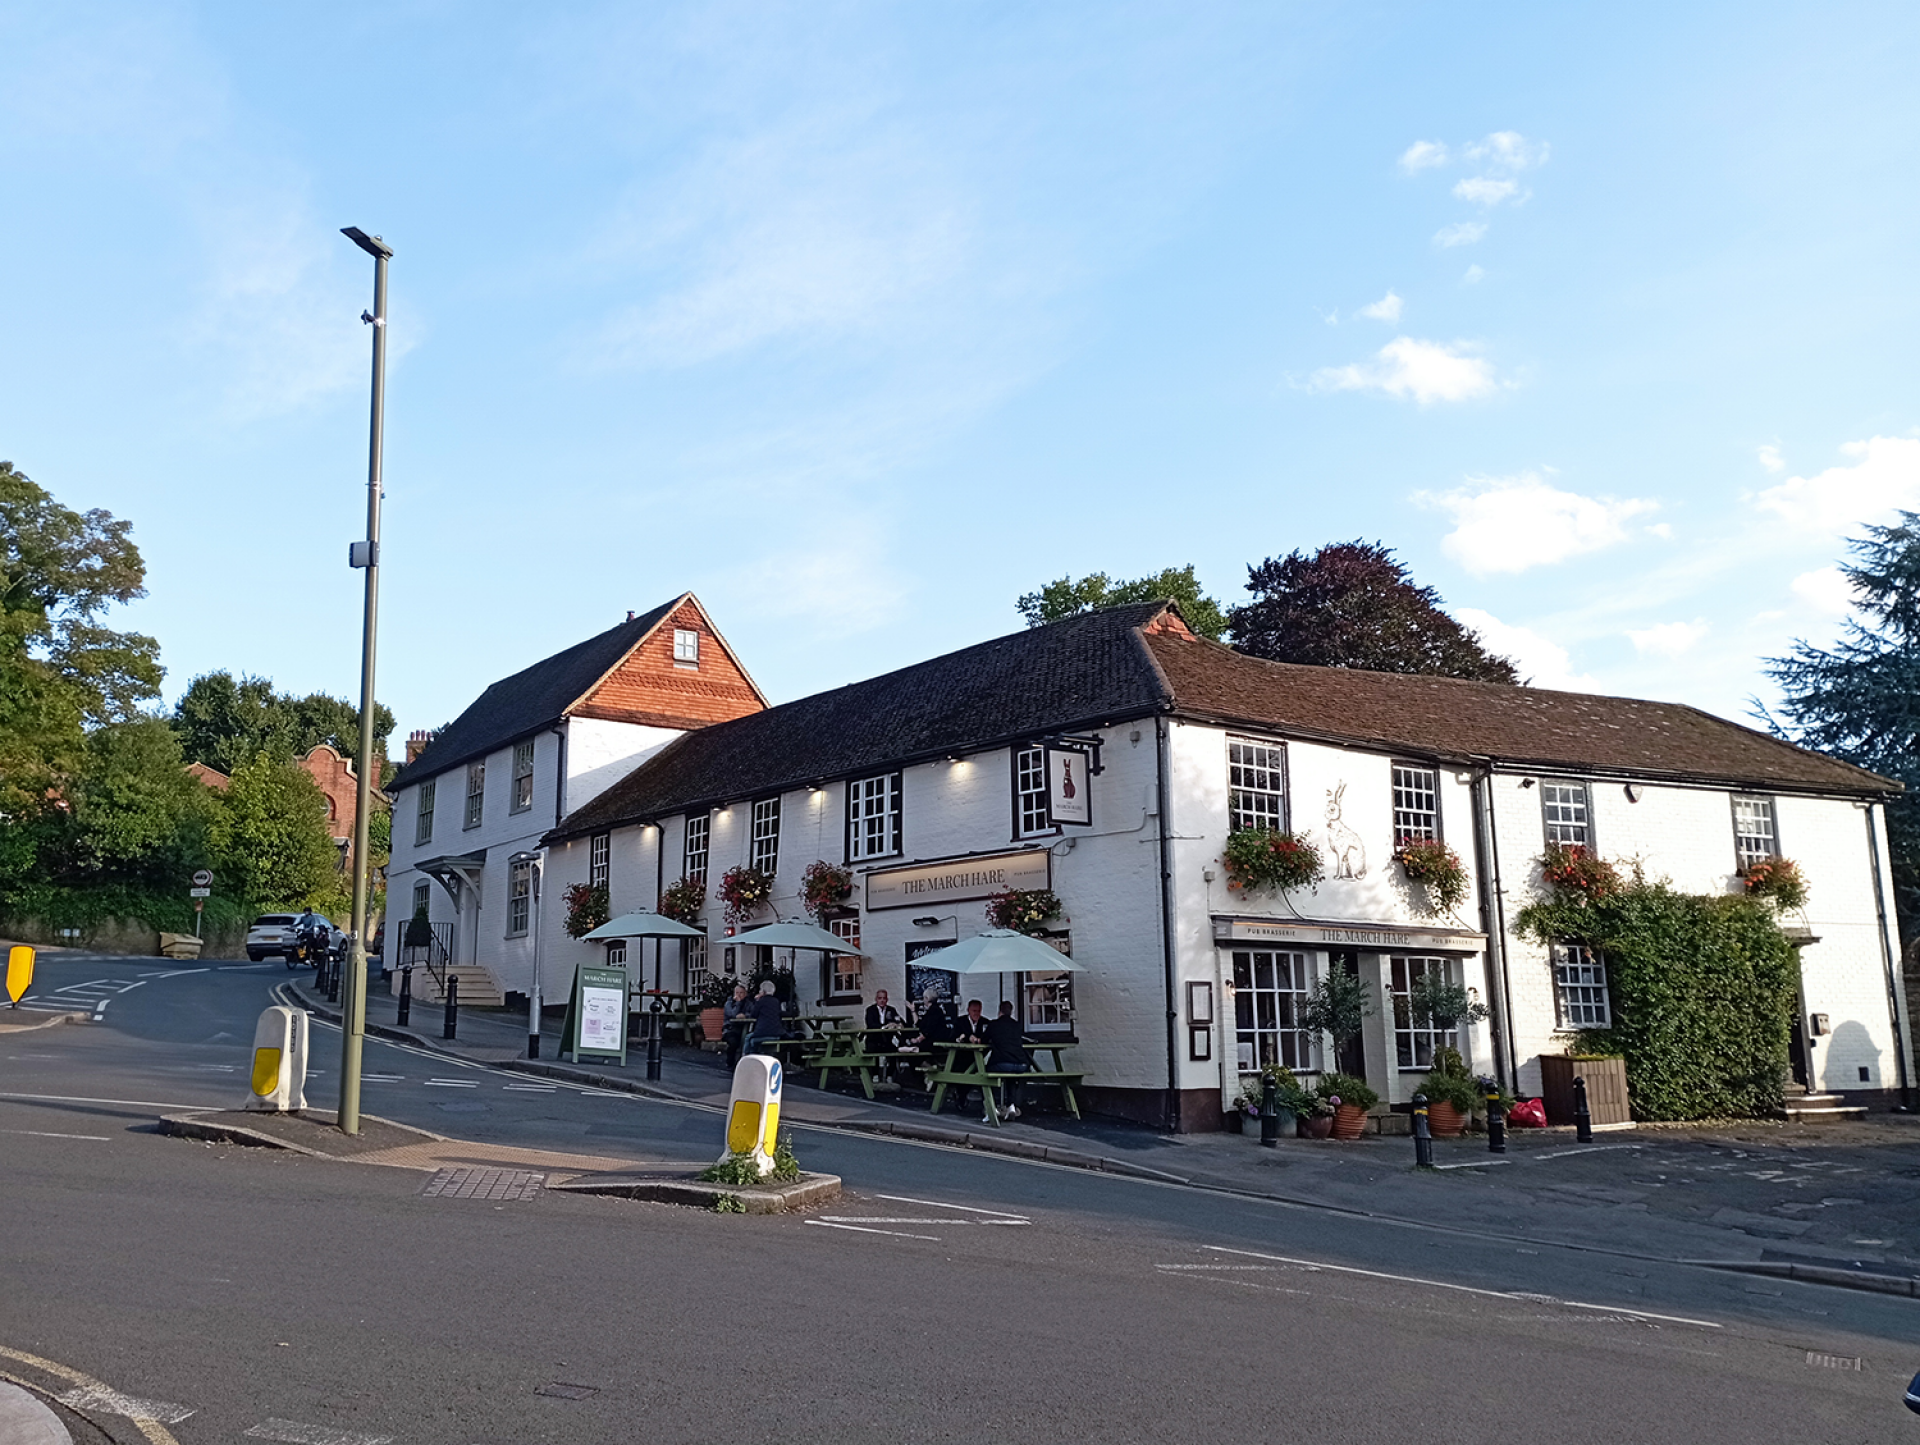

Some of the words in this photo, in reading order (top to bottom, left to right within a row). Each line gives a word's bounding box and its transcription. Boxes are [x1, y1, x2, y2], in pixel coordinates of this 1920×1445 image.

[902, 878, 925, 894] THE
[927, 873, 969, 891] MARCH
[971, 868, 1006, 886] HARE
[1247, 927, 1260, 935] PUB
[1262, 929, 1296, 937] BRASSERIE
[1320, 929, 1341, 941] THE
[1343, 930, 1381, 943] MARCH
[1383, 932, 1410, 945] HARE
[1444, 938, 1473, 946] BRASSERIE
[584, 974, 606, 983] MARCH
